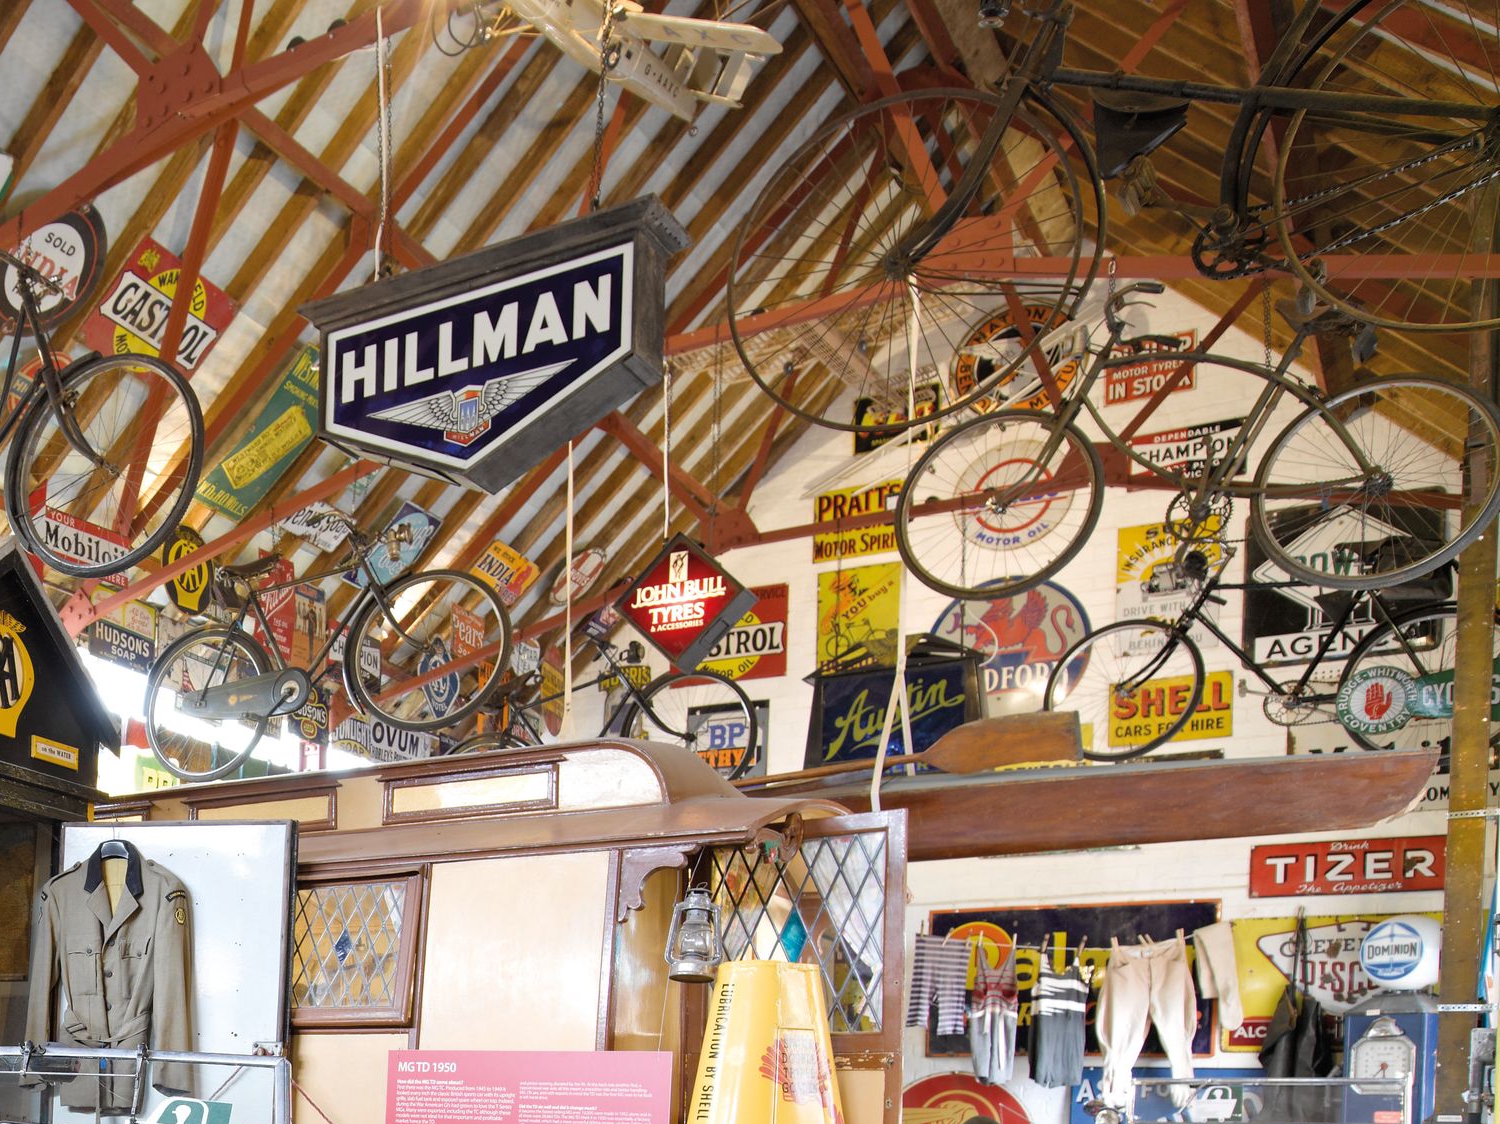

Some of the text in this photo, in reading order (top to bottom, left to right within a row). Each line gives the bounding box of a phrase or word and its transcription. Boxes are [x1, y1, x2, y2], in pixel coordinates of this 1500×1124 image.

[44, 231, 77, 258] SOLD
[111, 281, 211, 366] CASTOL
[341, 273, 613, 405] HILLMAN
[1112, 365, 1149, 381] MOTOR
[1108, 381, 1128, 401] IN
[1153, 424, 1222, 444] DEPENDABLE
[50, 510, 76, 528] YOUR
[975, 521, 1050, 546] MOTOR OIL
[814, 531, 895, 561] MOTOR SPIRI
[477, 552, 517, 587] INDIA
[631, 575, 727, 608] JOHN BULL
[841, 584, 889, 621] YOU buy
[648, 601, 706, 625] TYRES
[1123, 600, 1187, 618] DRIVE WITH
[650, 619, 704, 632] & ACCESSORIES
[95, 622, 150, 658] HUDSON'S
[1128, 637, 1167, 651] BEHIN
[111, 645, 137, 661] SOAP
[738, 658, 755, 673] OIL
[1113, 678, 1231, 720] SHELL
[1114, 716, 1225, 738] CARS HIRE
[1343, 706, 1412, 733] COVENTRY
[371, 721, 420, 758] OVUM
[709, 722, 746, 749] BP
[56, 749, 71, 760] WATER
[1330, 840, 1370, 852] Drink
[1264, 849, 1438, 885] TIZER
[1332, 879, 1403, 894] Appetizer
[1366, 942, 1418, 959] DOMINION
[696, 983, 736, 1121] LUBRICATION BY SHELL
[397, 1061, 457, 1073] MG TD 1950
